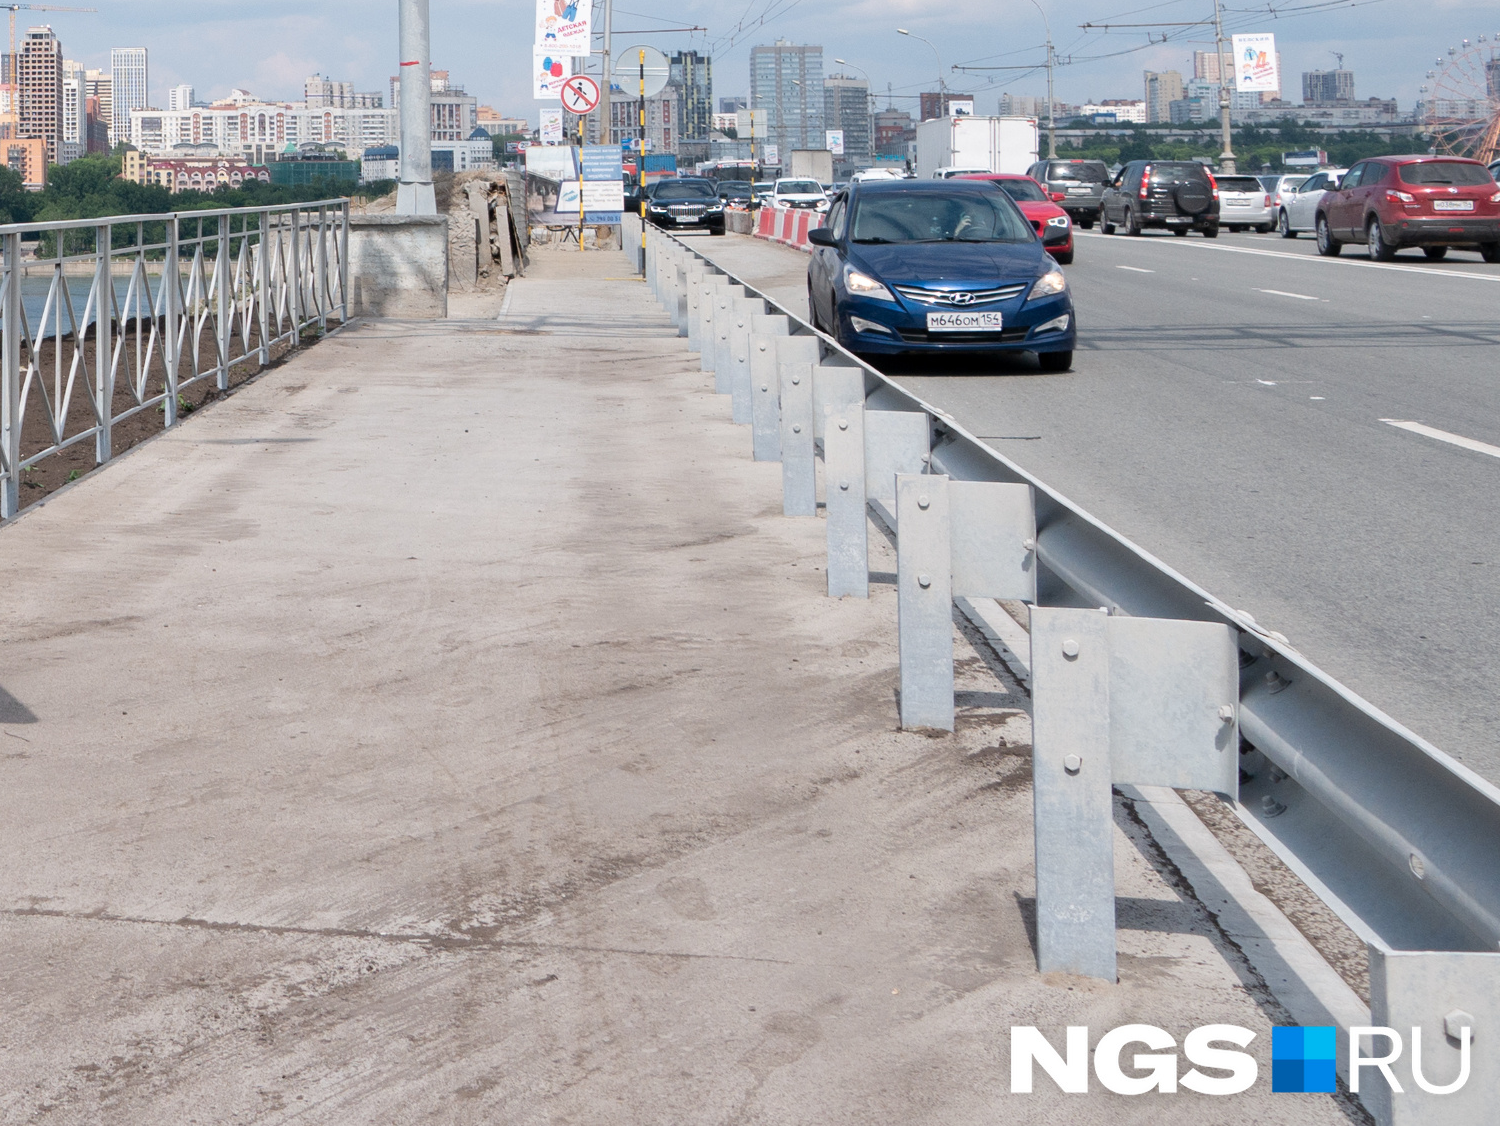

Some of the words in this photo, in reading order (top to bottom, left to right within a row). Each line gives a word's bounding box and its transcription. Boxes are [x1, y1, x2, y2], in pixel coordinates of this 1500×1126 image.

[557, 20, 587, 33] ДЕТСКАЯ
[562, 28, 585, 38] ОДЕЖДА
[930, 314, 979, 326] М646ОМ
[981, 313, 1000, 323] 154
